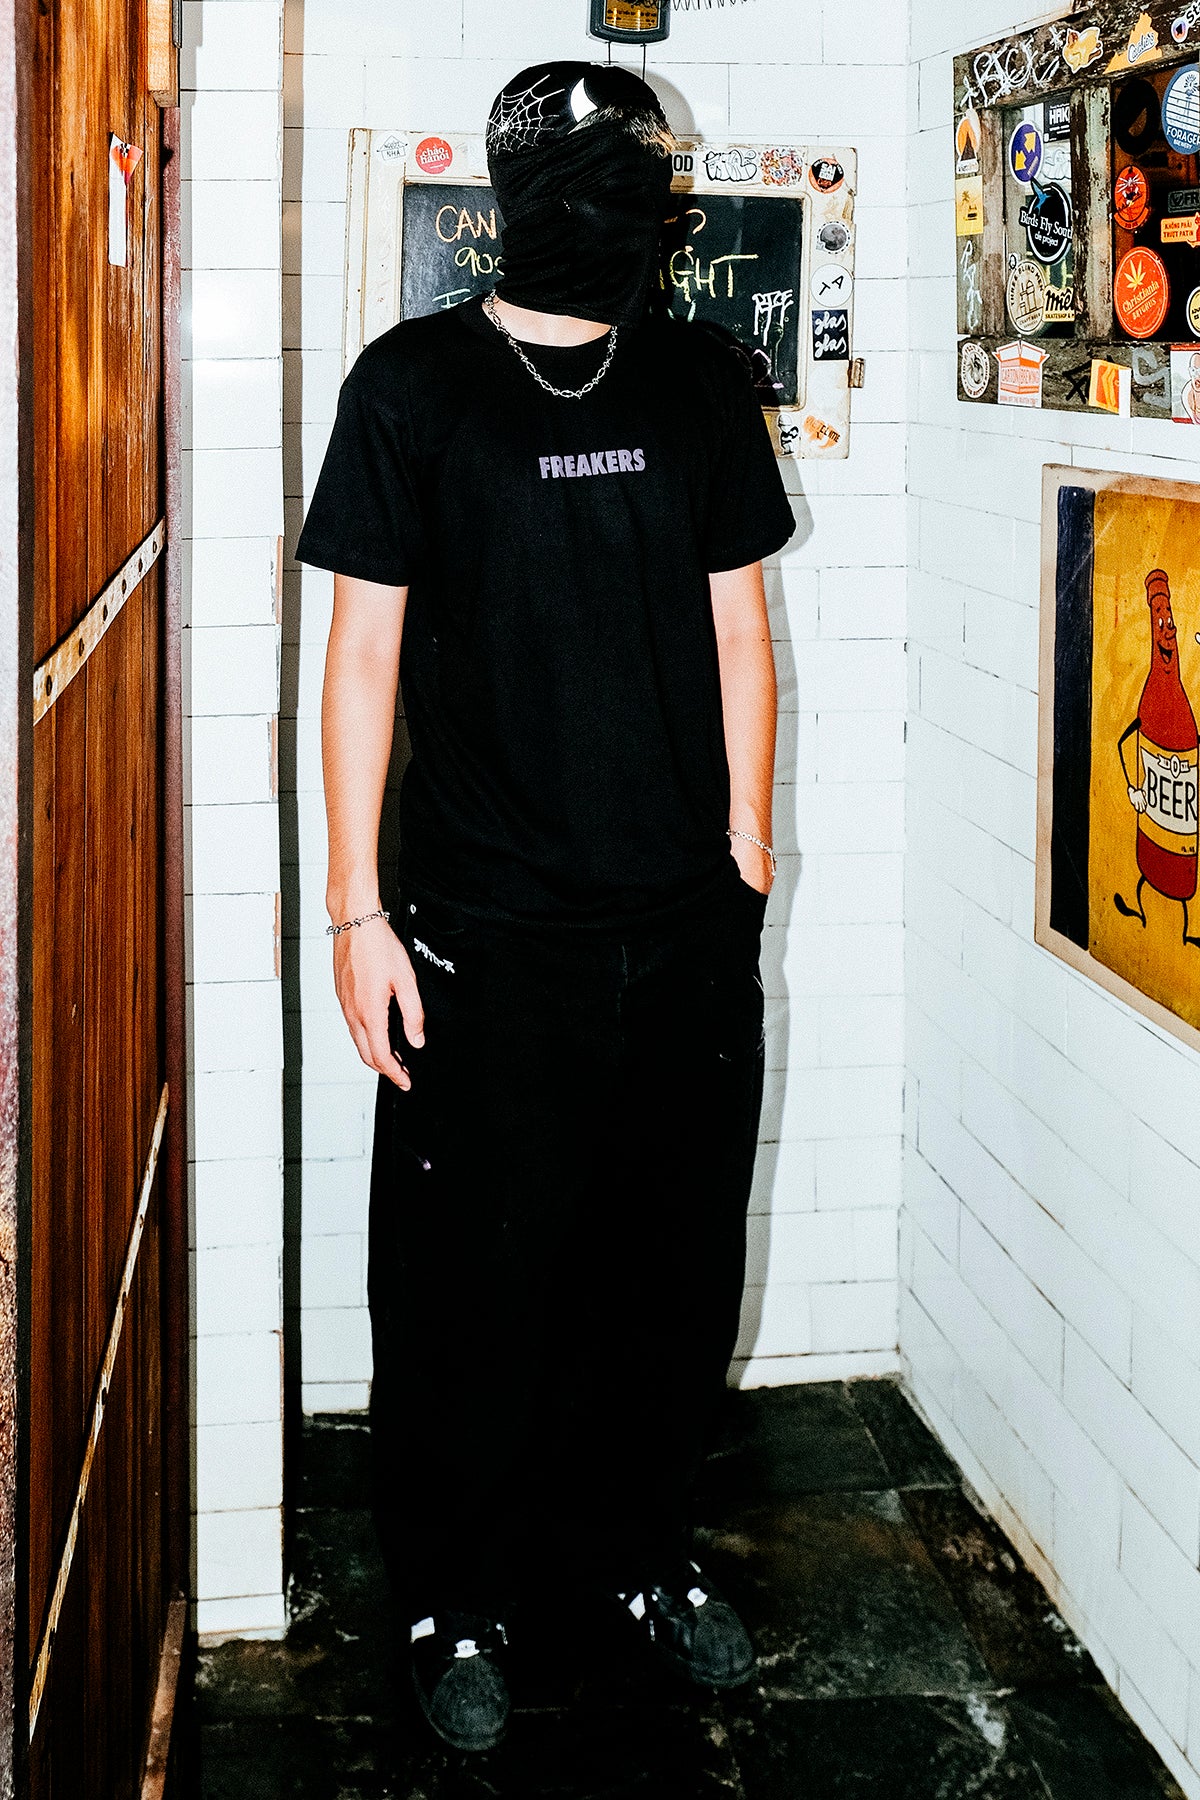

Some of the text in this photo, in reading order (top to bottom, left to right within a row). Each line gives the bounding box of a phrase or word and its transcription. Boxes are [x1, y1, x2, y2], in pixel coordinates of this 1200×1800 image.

[673, 154, 693, 172] OD
[435, 205, 497, 243] CAN
[1021, 210, 1038, 228] Birds
[1040, 216, 1053, 236] Fly
[538, 448, 646, 479] FREAKERS
[1147, 766, 1198, 822] BEER
